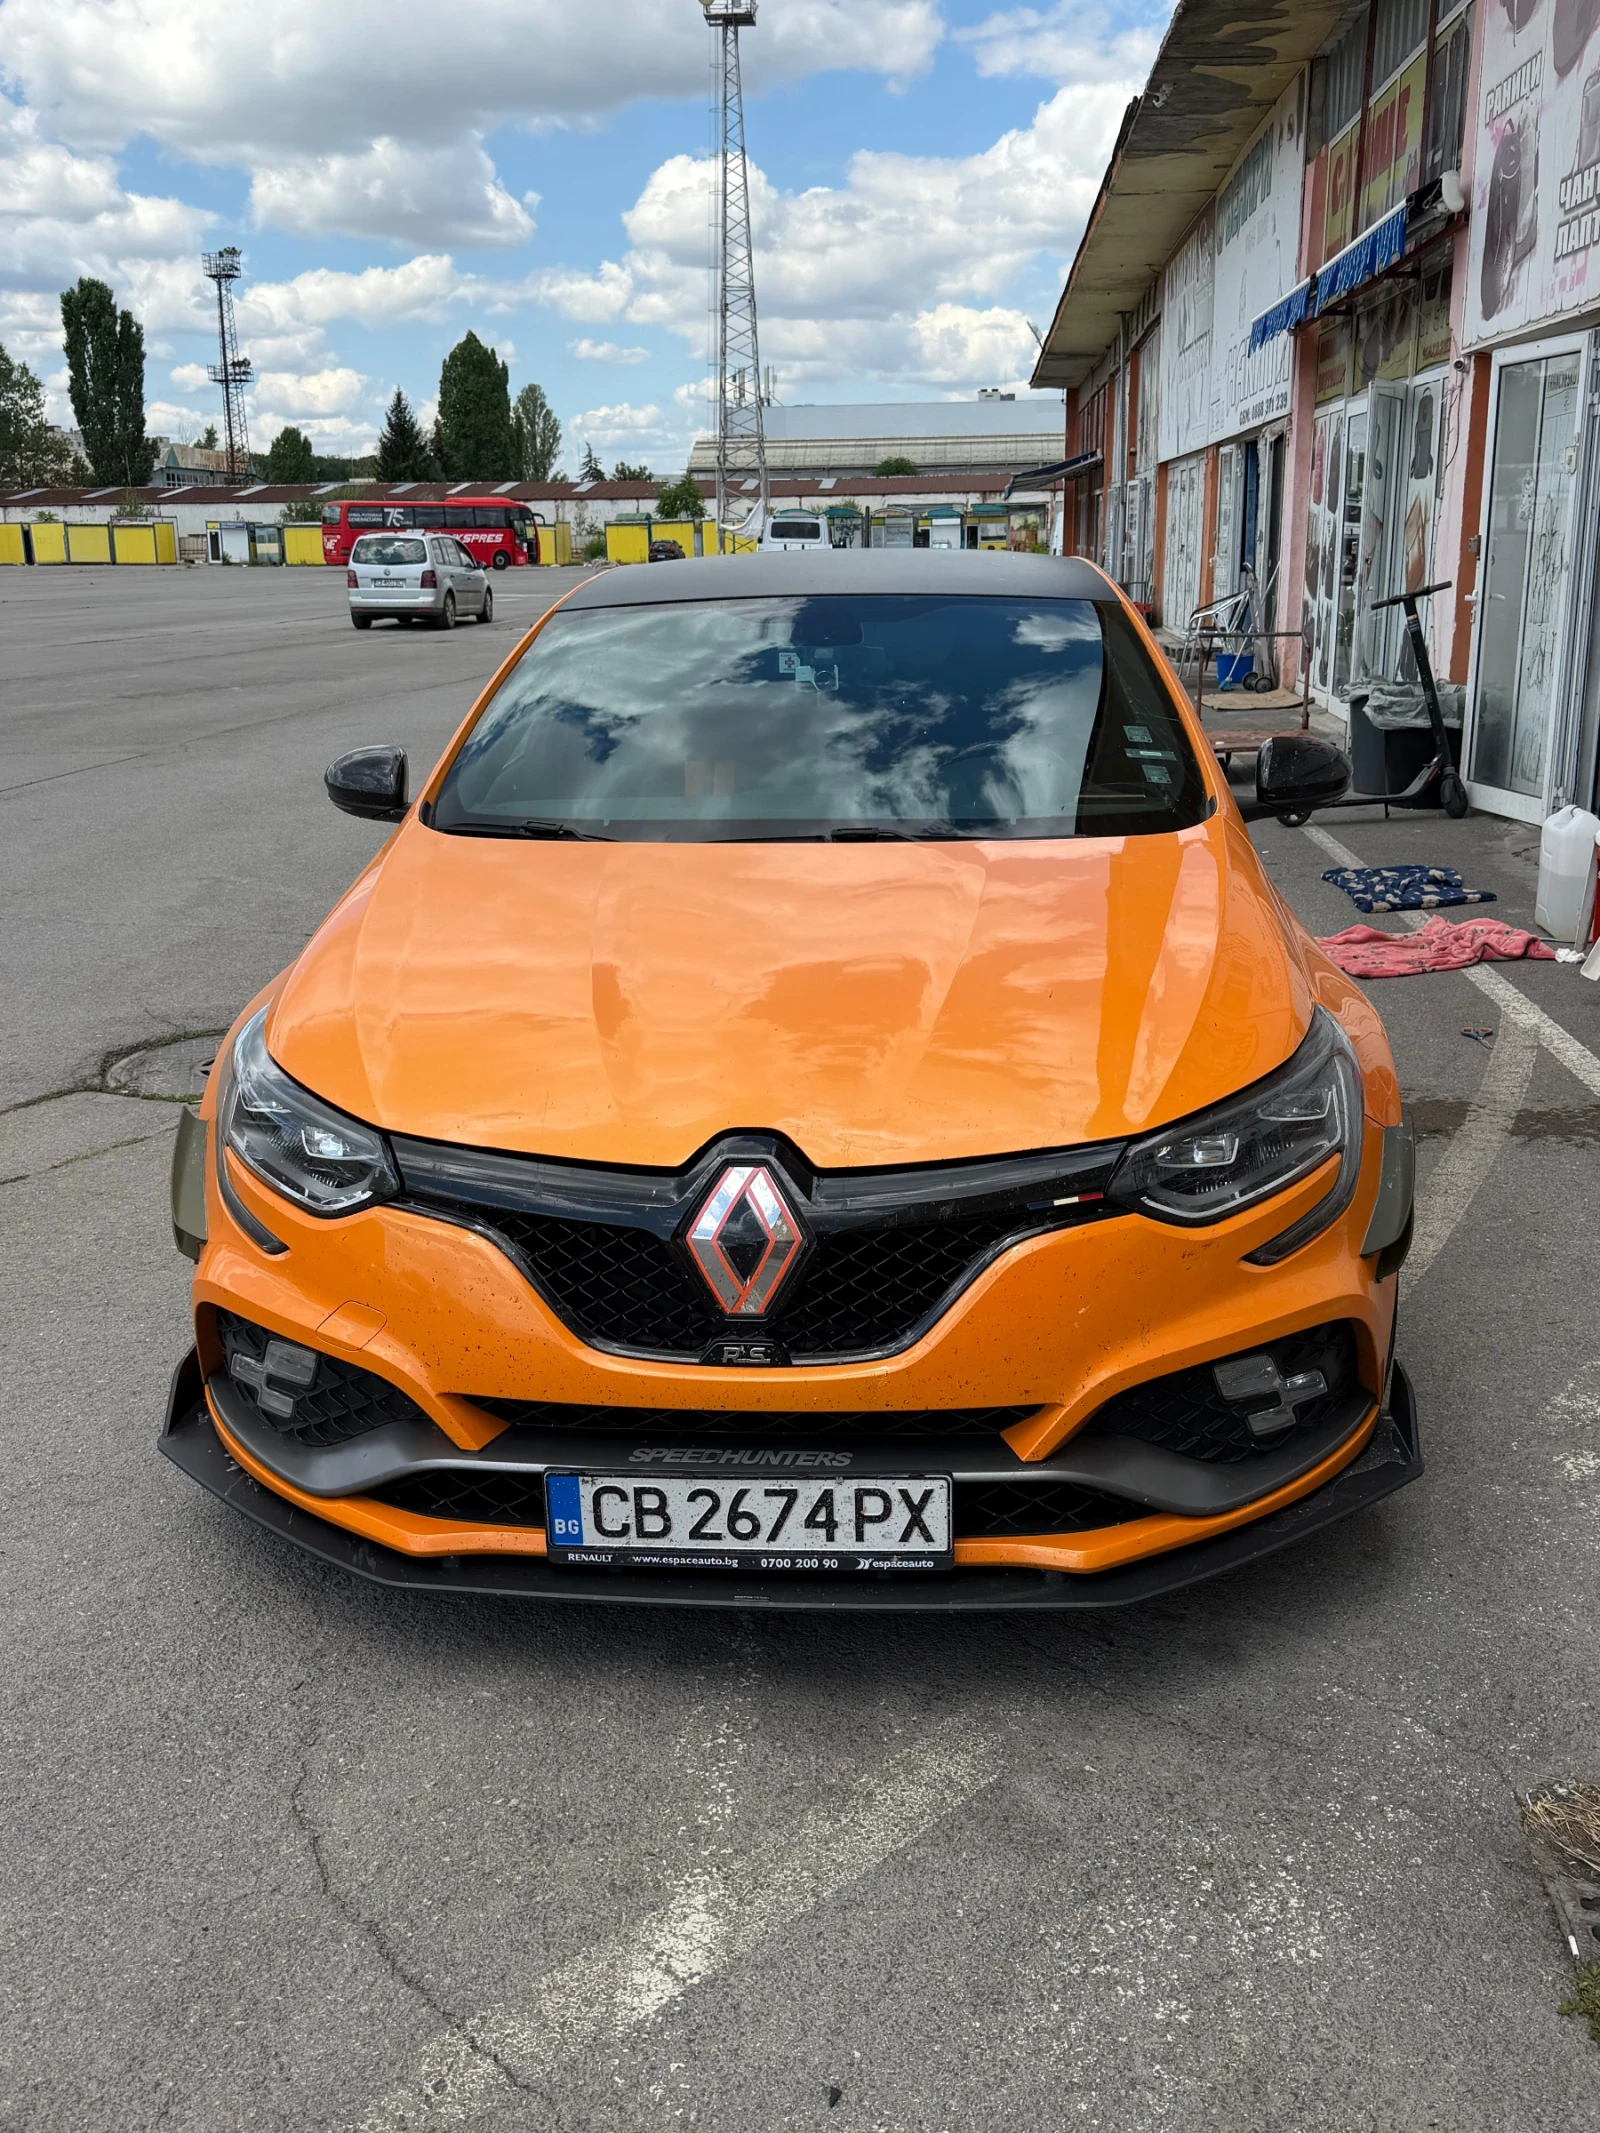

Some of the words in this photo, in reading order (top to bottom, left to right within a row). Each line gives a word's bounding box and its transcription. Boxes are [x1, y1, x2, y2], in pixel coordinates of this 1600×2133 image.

[1485, 50, 1542, 128] РАНИЦИ
[1555, 208, 1600, 259] ЛАПТ
[1276, 391, 1288, 411] 239
[383, 507, 404, 527] 75
[628, 1448, 853, 1467] SPEEDHUNTERS
[592, 1485, 672, 1539] CB
[686, 1487, 839, 1542] 2674
[854, 1486, 935, 1543] PX
[554, 1518, 580, 1535] BG
[567, 1553, 613, 1563] RENAULT
[632, 1553, 739, 1568] www.espaceauto.bg
[760, 1558, 791, 1569] 0700
[795, 1558, 819, 1569] 200
[822, 1558, 839, 1569] 90
[872, 1559, 935, 1570] espaceauto
